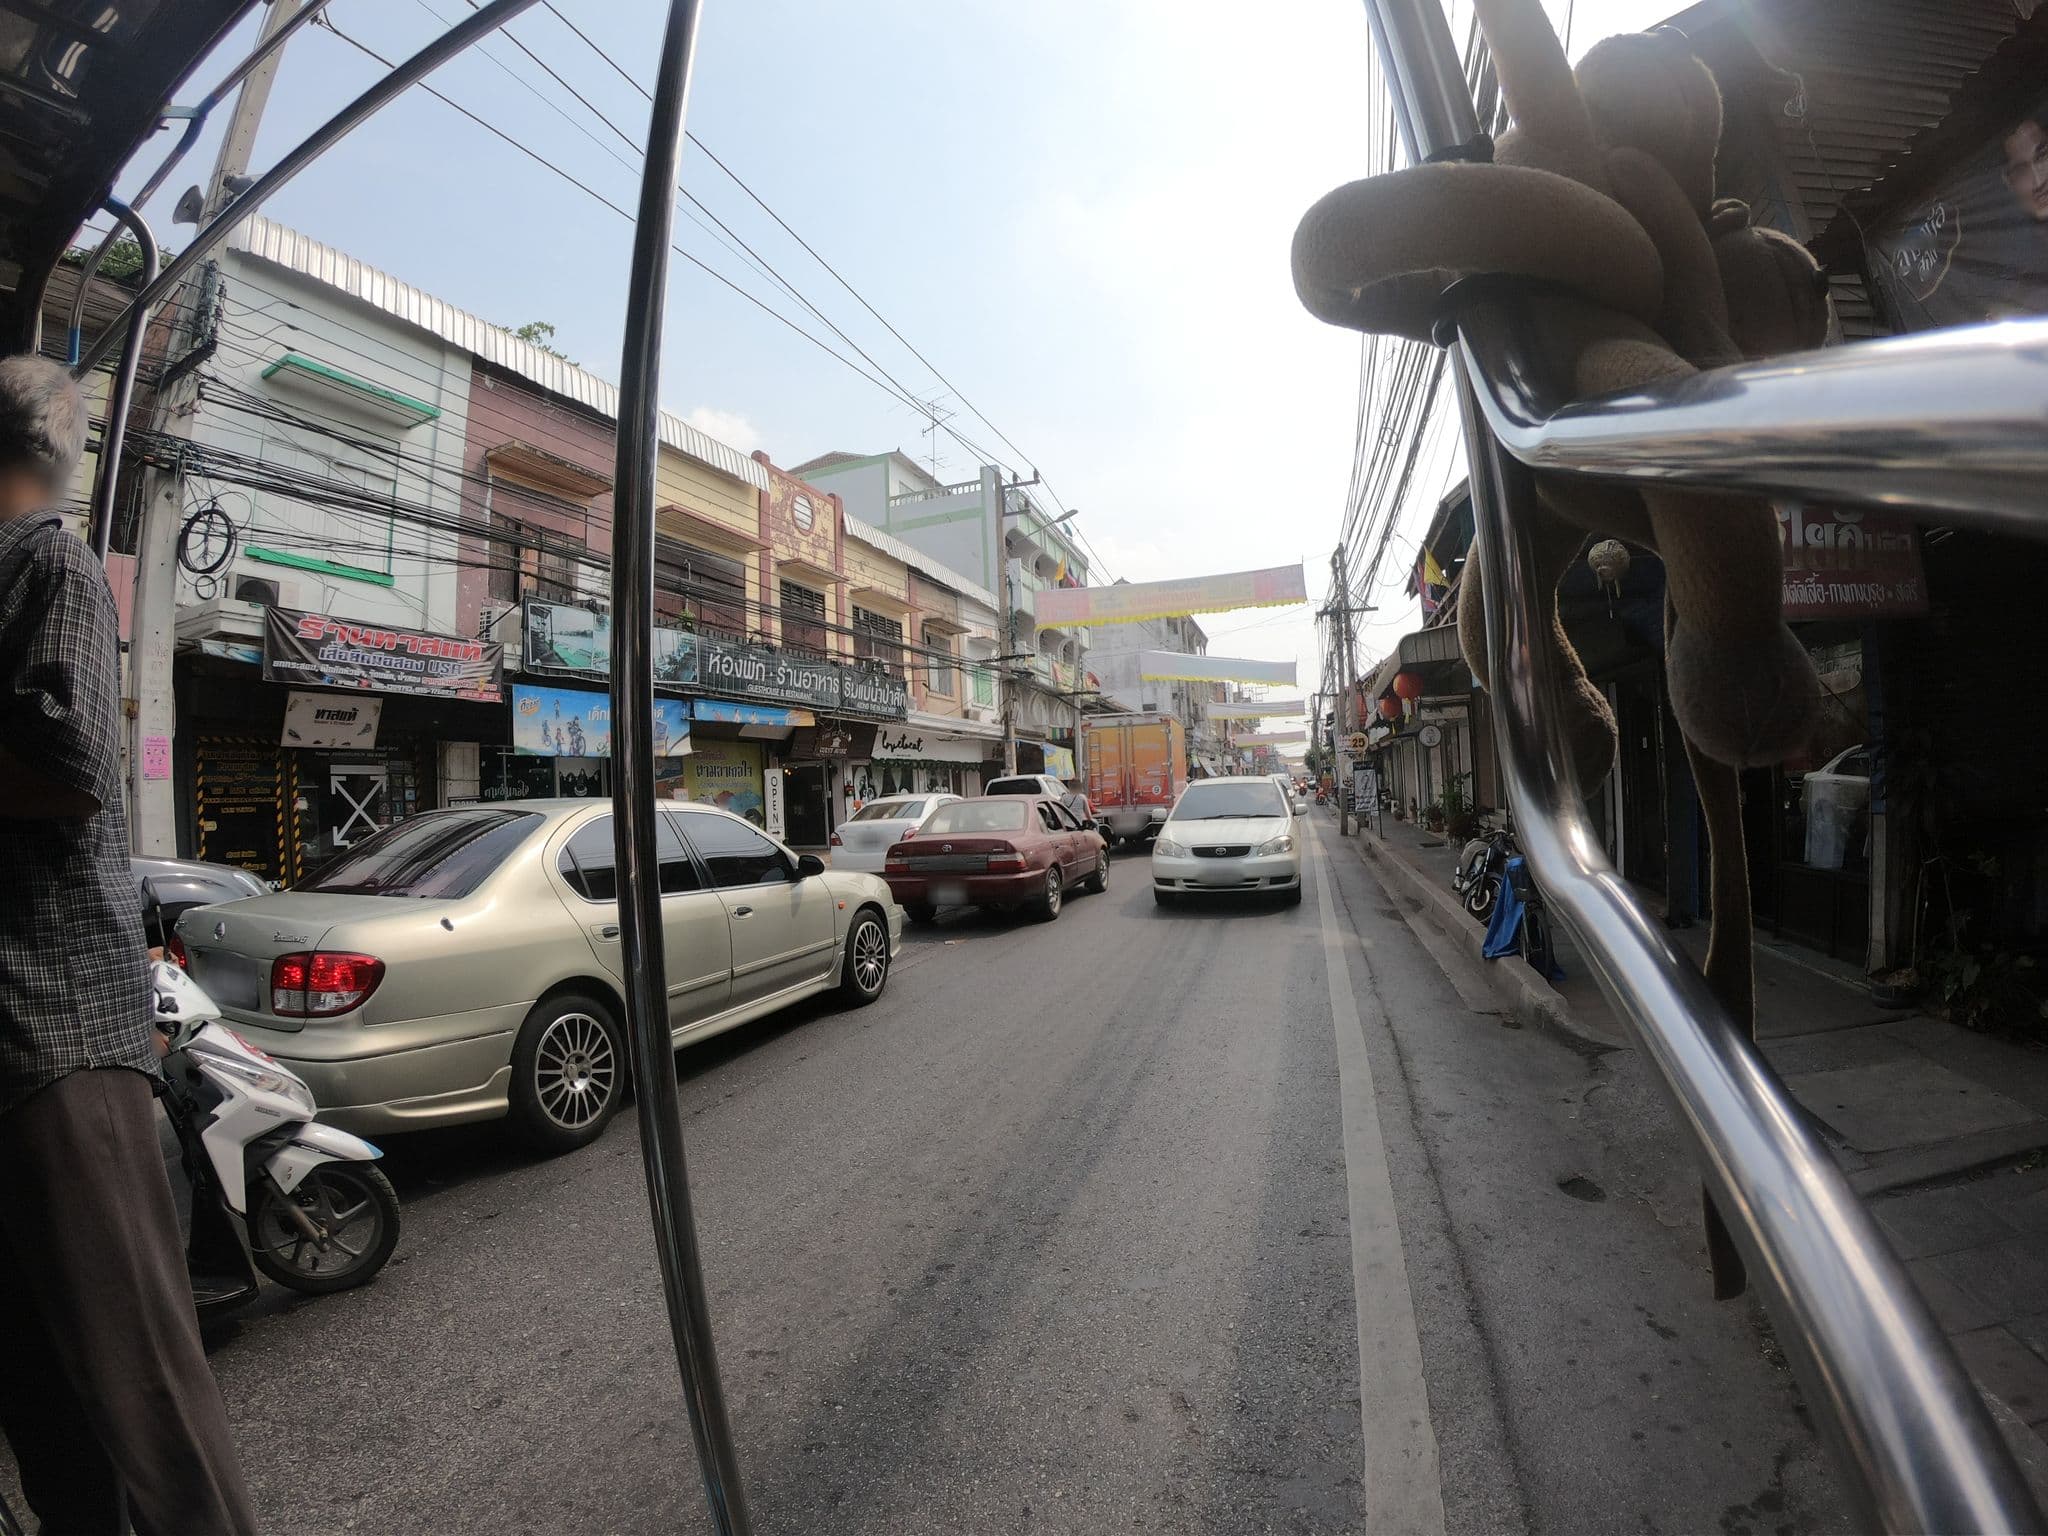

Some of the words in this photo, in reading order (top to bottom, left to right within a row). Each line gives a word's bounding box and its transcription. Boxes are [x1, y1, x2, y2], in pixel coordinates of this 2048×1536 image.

[295, 613, 489, 661] ร้านทาสแท้
[319, 641, 425, 672] เสื้อยืดมือสอง
[708, 646, 765, 682] ห้องพัก
[777, 660, 839, 694] ร้านอาหาร
[844, 675, 906, 708] ริมแม่น้ำป่าสัก
[315, 707, 359, 721] ทาสแท้
[770, 776, 779, 824] OPEN
